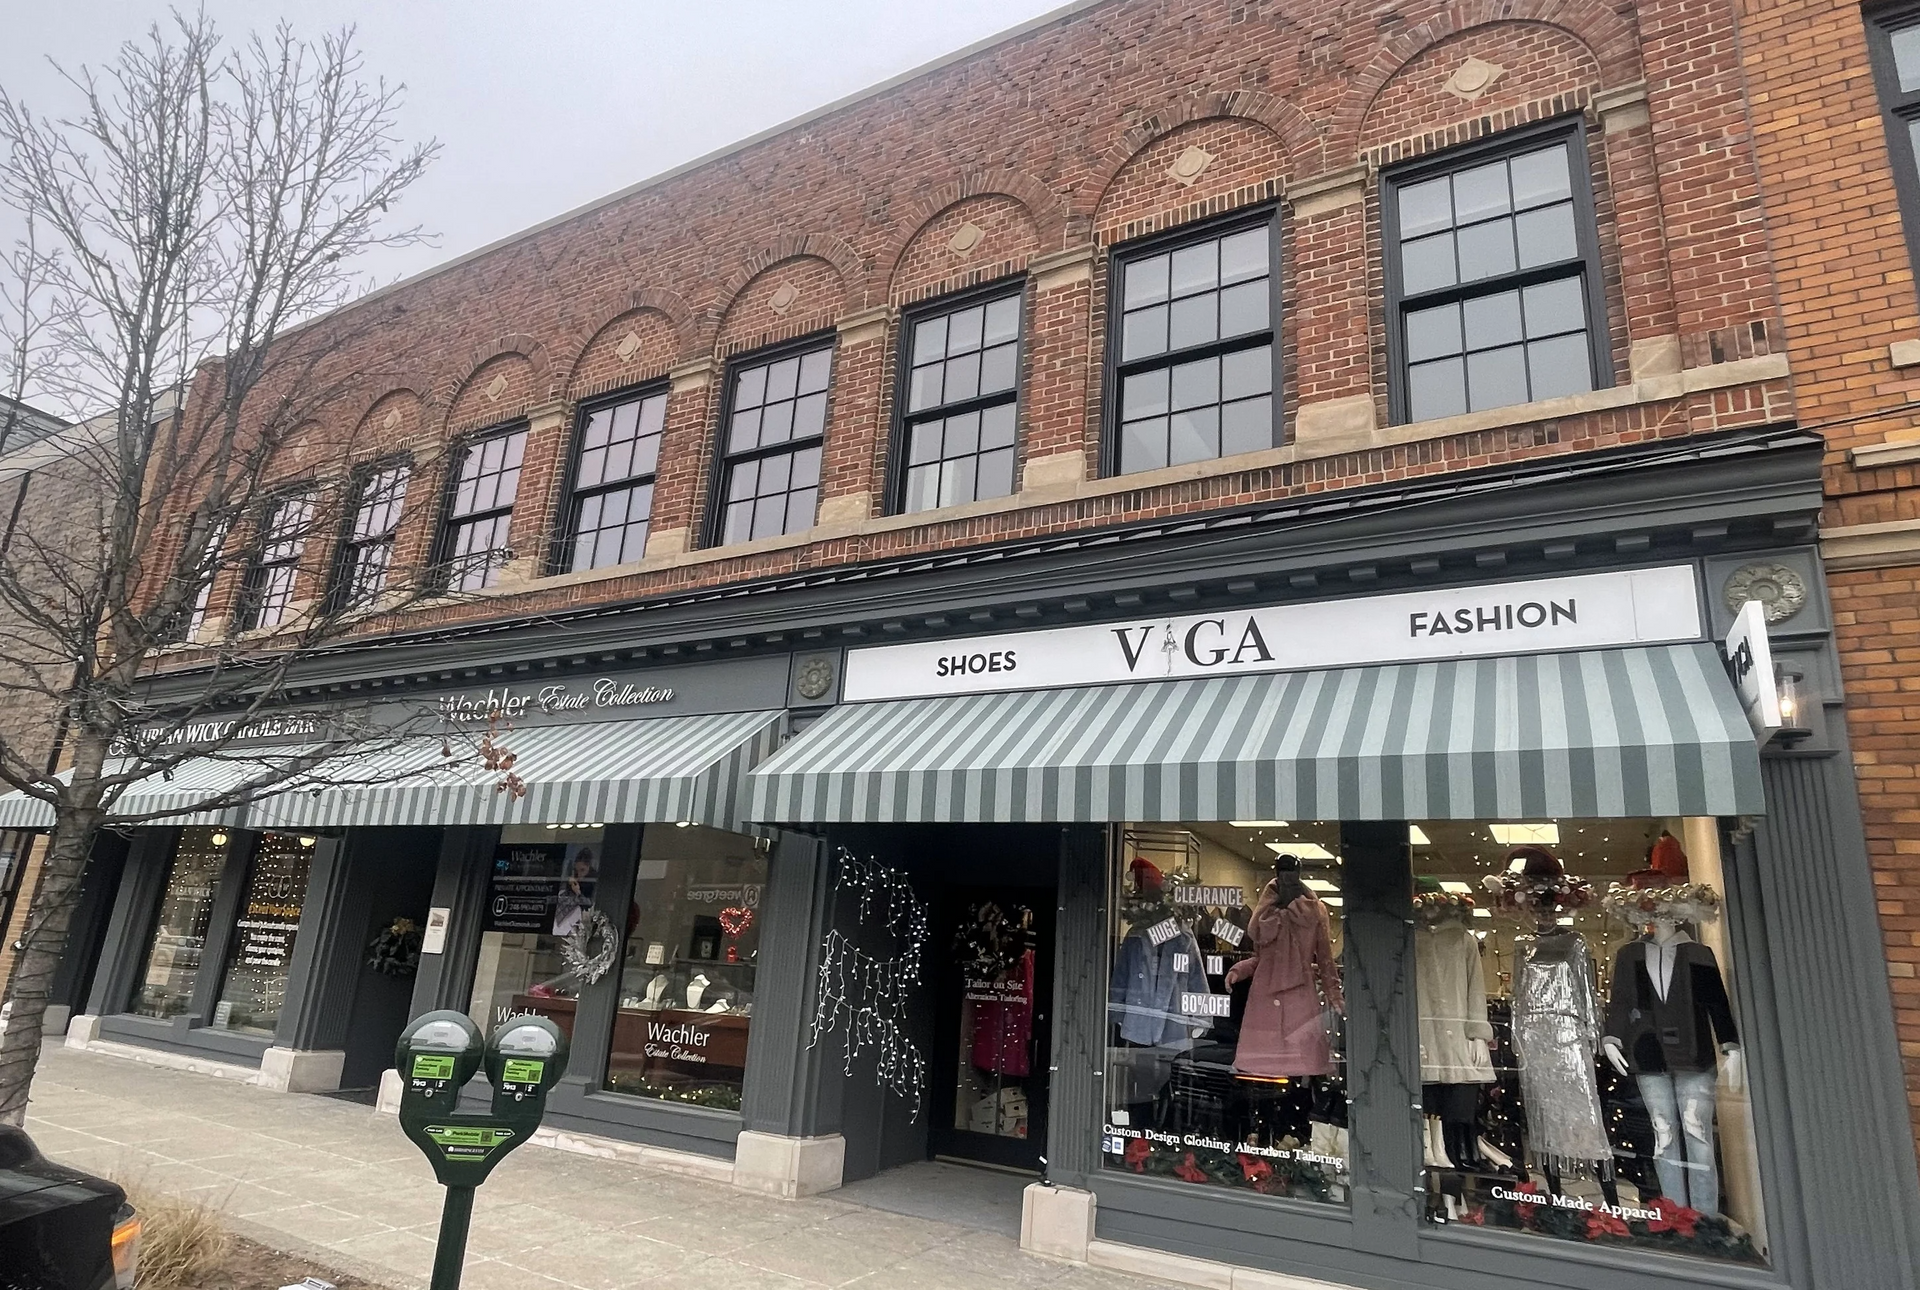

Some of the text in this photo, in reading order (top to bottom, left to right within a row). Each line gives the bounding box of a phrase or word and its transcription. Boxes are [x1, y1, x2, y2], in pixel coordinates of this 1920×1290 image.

[1410, 598, 1578, 638] FASHION
[936, 650, 1017, 677] SHOES
[440, 678, 675, 723] Wachler Estate Collection
[186, 722, 224, 743] WICK
[511, 849, 547, 862] Wachler
[1174, 886, 1243, 906] CLEARANCE
[1148, 917, 1244, 947] HUGE SALE
[1173, 953, 1223, 975] UP TO
[965, 979, 1024, 991] Tailor on Site
[965, 992, 1028, 1005] Alterations Tailoring
[497, 1006, 549, 1022] Wachl
[647, 1021, 710, 1047] Wachler
[644, 1043, 707, 1063] Estate Collection
[1103, 1124, 1142, 1138] Custom
[1145, 1129, 1180, 1146] Design
[1235, 1142, 1290, 1159] Alterations
[1292, 1148, 1344, 1169] Tailoring
[1491, 1186, 1663, 1221] Custom Made Apparel
